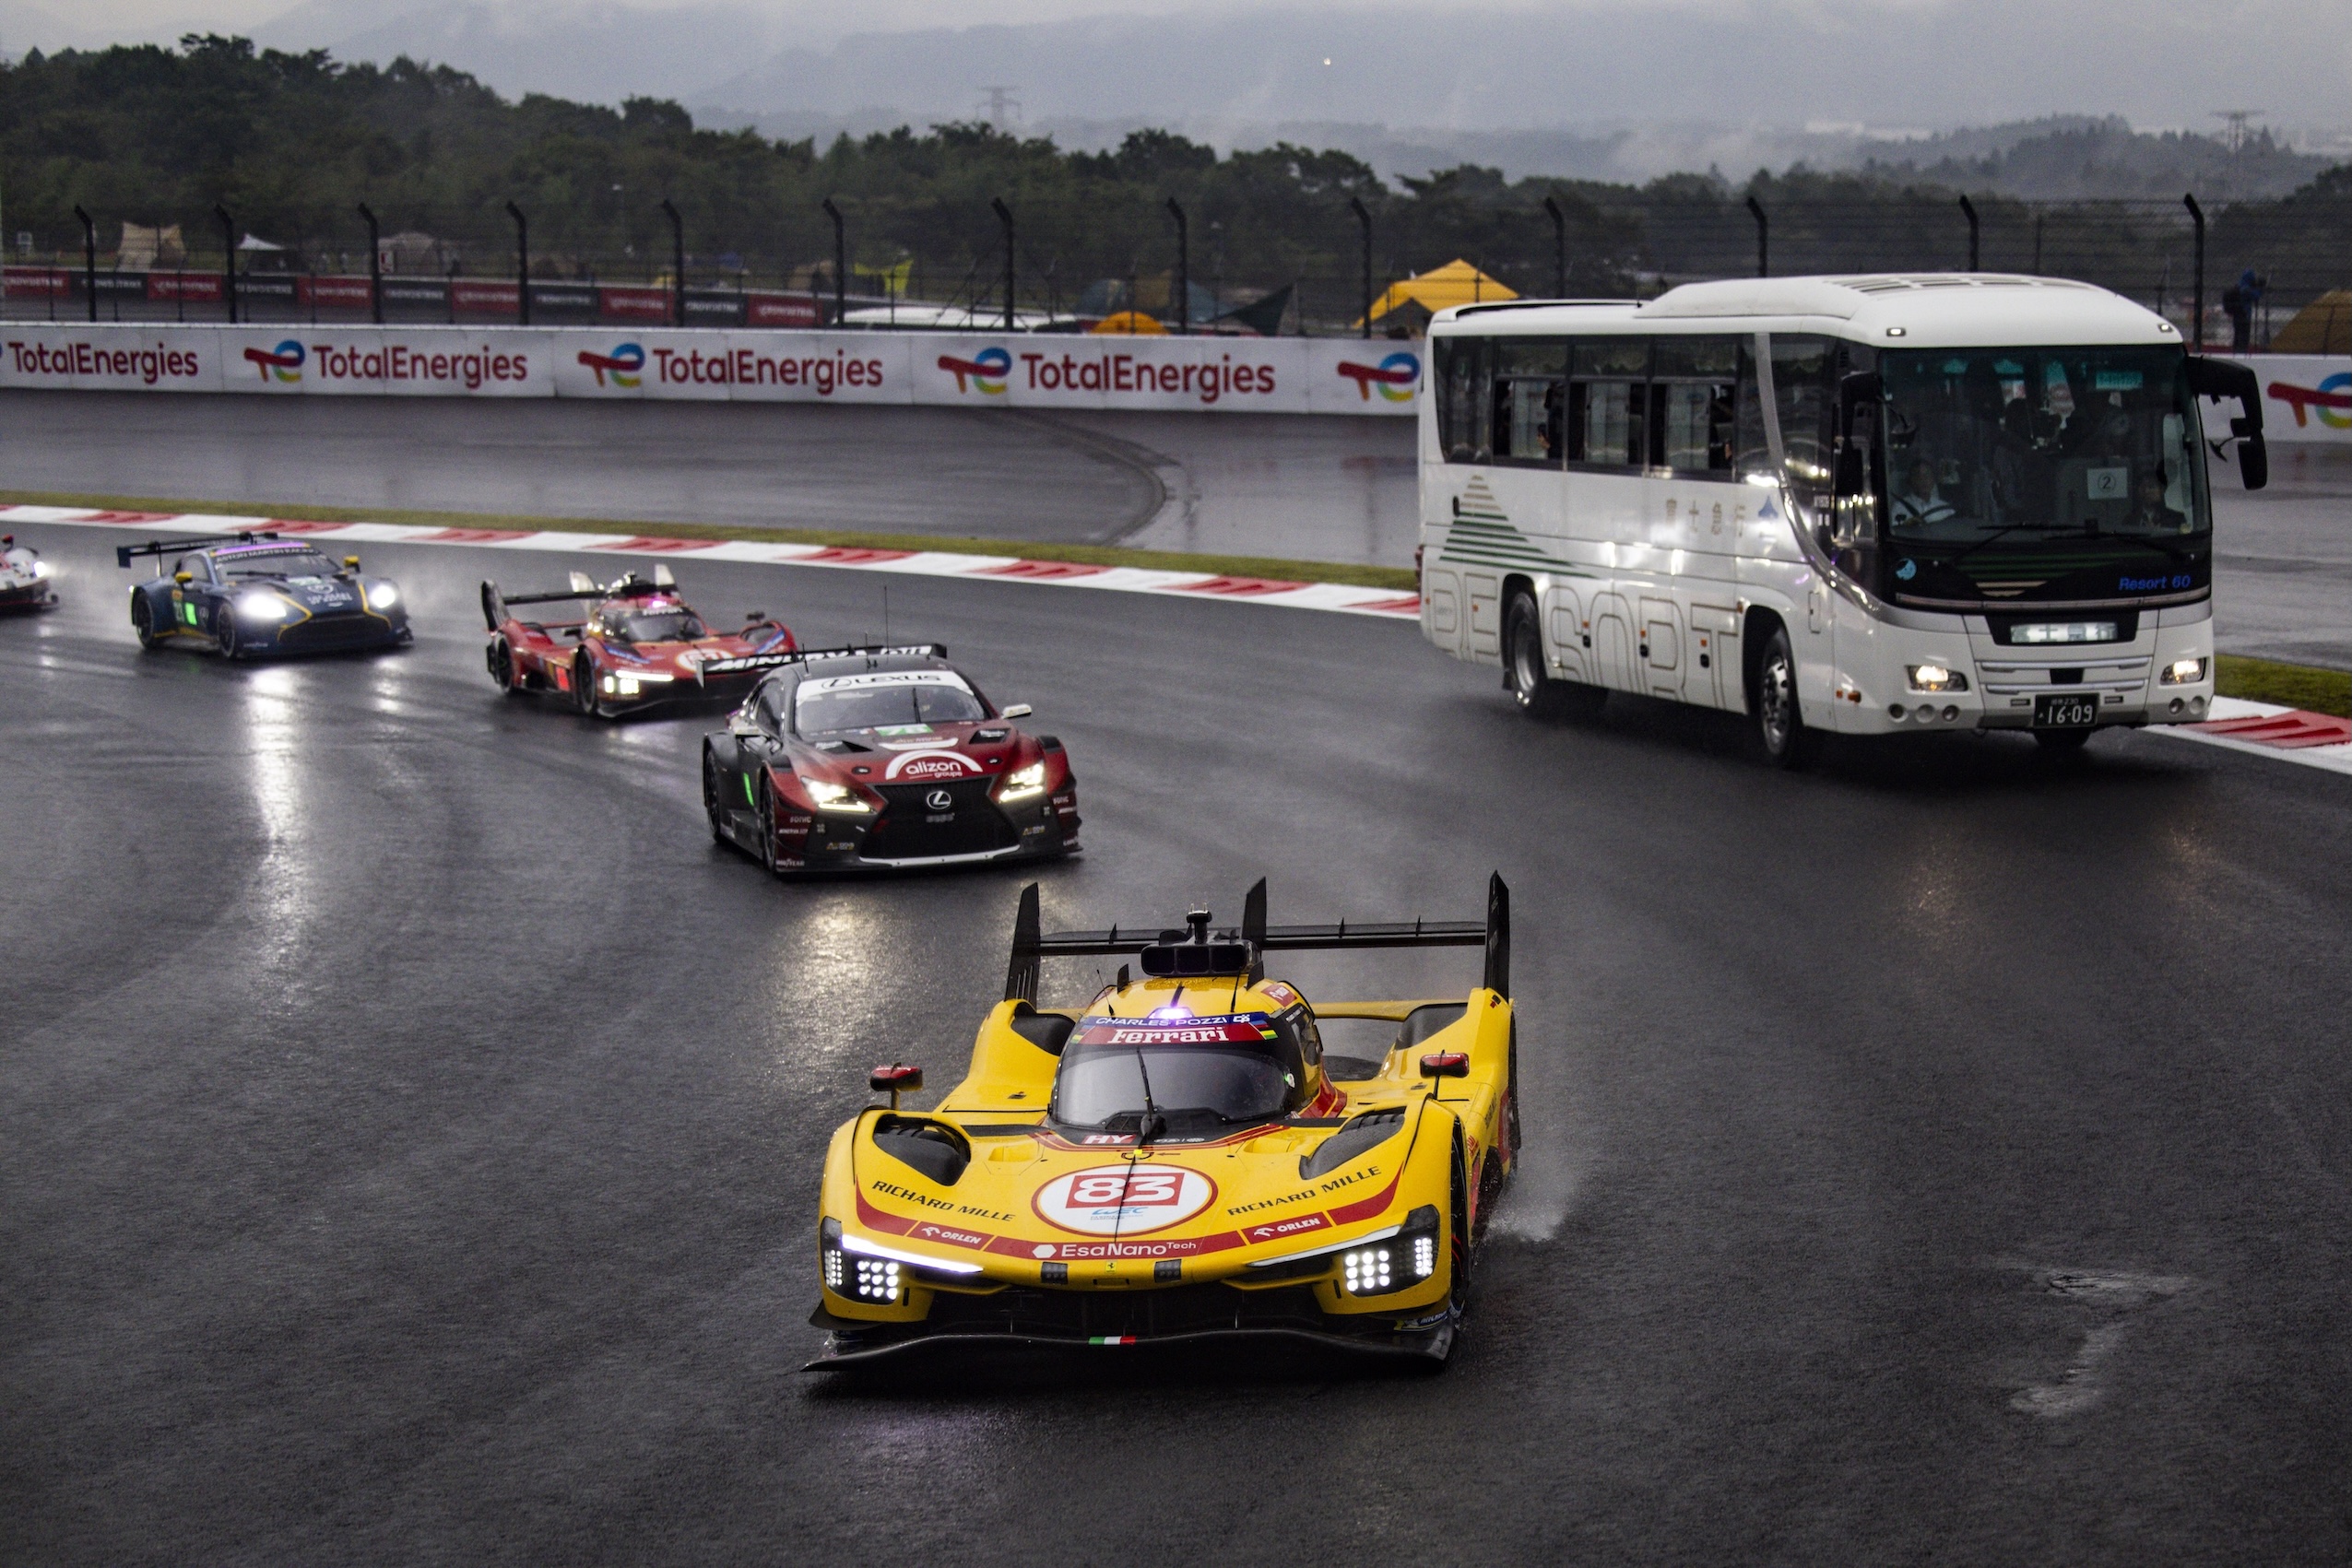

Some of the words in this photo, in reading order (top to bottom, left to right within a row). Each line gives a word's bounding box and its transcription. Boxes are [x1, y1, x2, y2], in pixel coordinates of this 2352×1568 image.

[8, 341, 198, 384] TotalEnergies
[312, 345, 527, 390] TotalEnergies
[652, 348, 883, 396] TotalEnergies
[1020, 354, 1276, 405] TotalEnergies
[2119, 576, 2167, 591] Resort
[2171, 575, 2192, 588] 60
[856, 675, 940, 685] LEXUS
[905, 760, 962, 775] alizon
[1095, 1017, 1170, 1026] CHARLES
[1176, 1017, 1227, 1026] POZZI
[1107, 1027, 1229, 1043] Ferrari
[1084, 1135, 1133, 1144] HY
[1073, 1175, 1176, 1203] 83
[1227, 1189, 1317, 1216] RICHARD
[1321, 1166, 1381, 1193] MILLE
[871, 1181, 954, 1211] RICHARD
[958, 1206, 1016, 1222] MILLE
[1091, 1207, 1149, 1216] WEC
[1277, 1218, 1321, 1232] ORLEN
[941, 1231, 982, 1244] ORLEN
